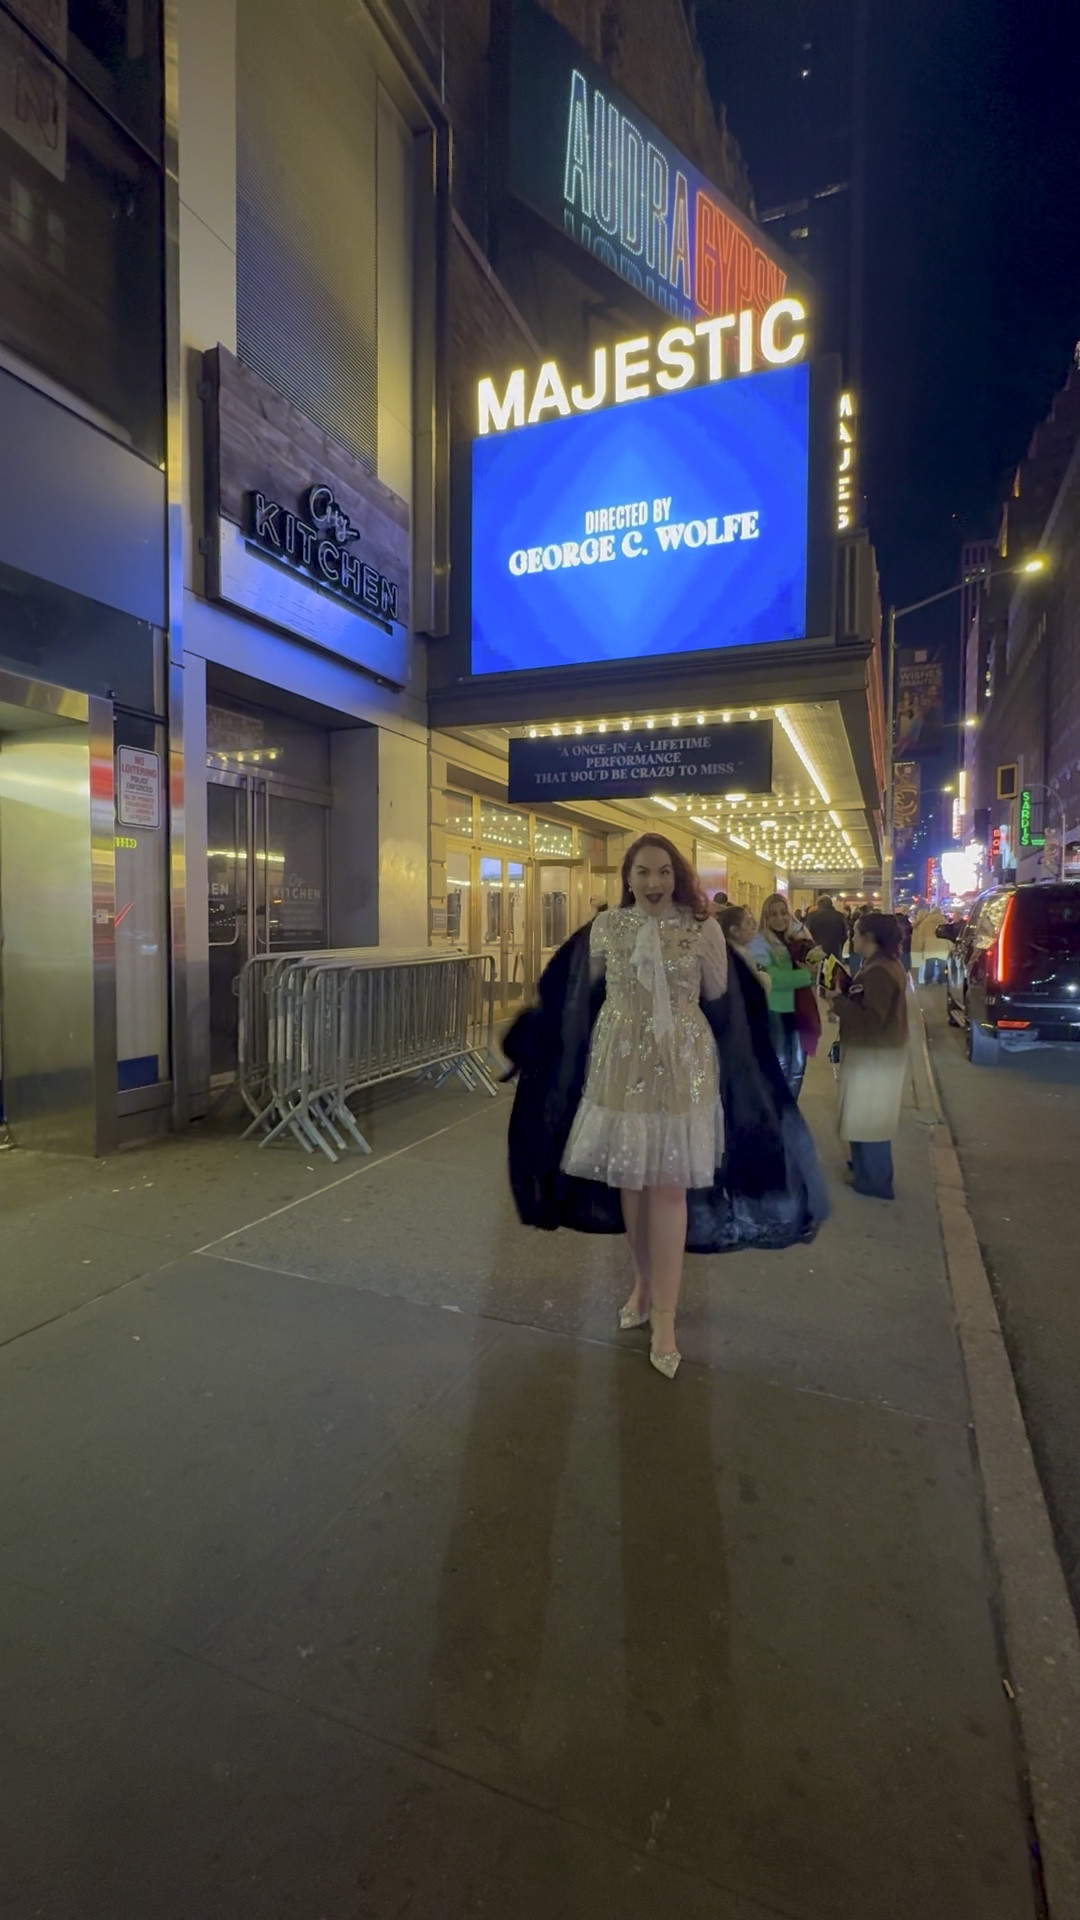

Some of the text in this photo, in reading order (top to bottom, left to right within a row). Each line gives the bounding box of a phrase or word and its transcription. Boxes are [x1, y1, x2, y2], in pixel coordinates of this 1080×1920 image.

[563, 68, 692, 300] AUDRA
[477, 298, 806, 435] MAJESTIC
[308, 486, 359, 543] City
[585, 496, 672, 535] DIRECTED BY
[253, 491, 400, 619] KITCHEN
[508, 511, 759, 576] GEORGE C. WOLFE
[121, 763, 157, 778] LOITERING
[572, 736, 711, 757] ONCE-IN-A-LIFETIME
[586, 752, 681, 768] PERFORMANCE
[535, 772, 568, 784] THAT
[612, 769, 628, 780] BE
[630, 764, 675, 779] CRAZY
[680, 765, 698, 776] TO
